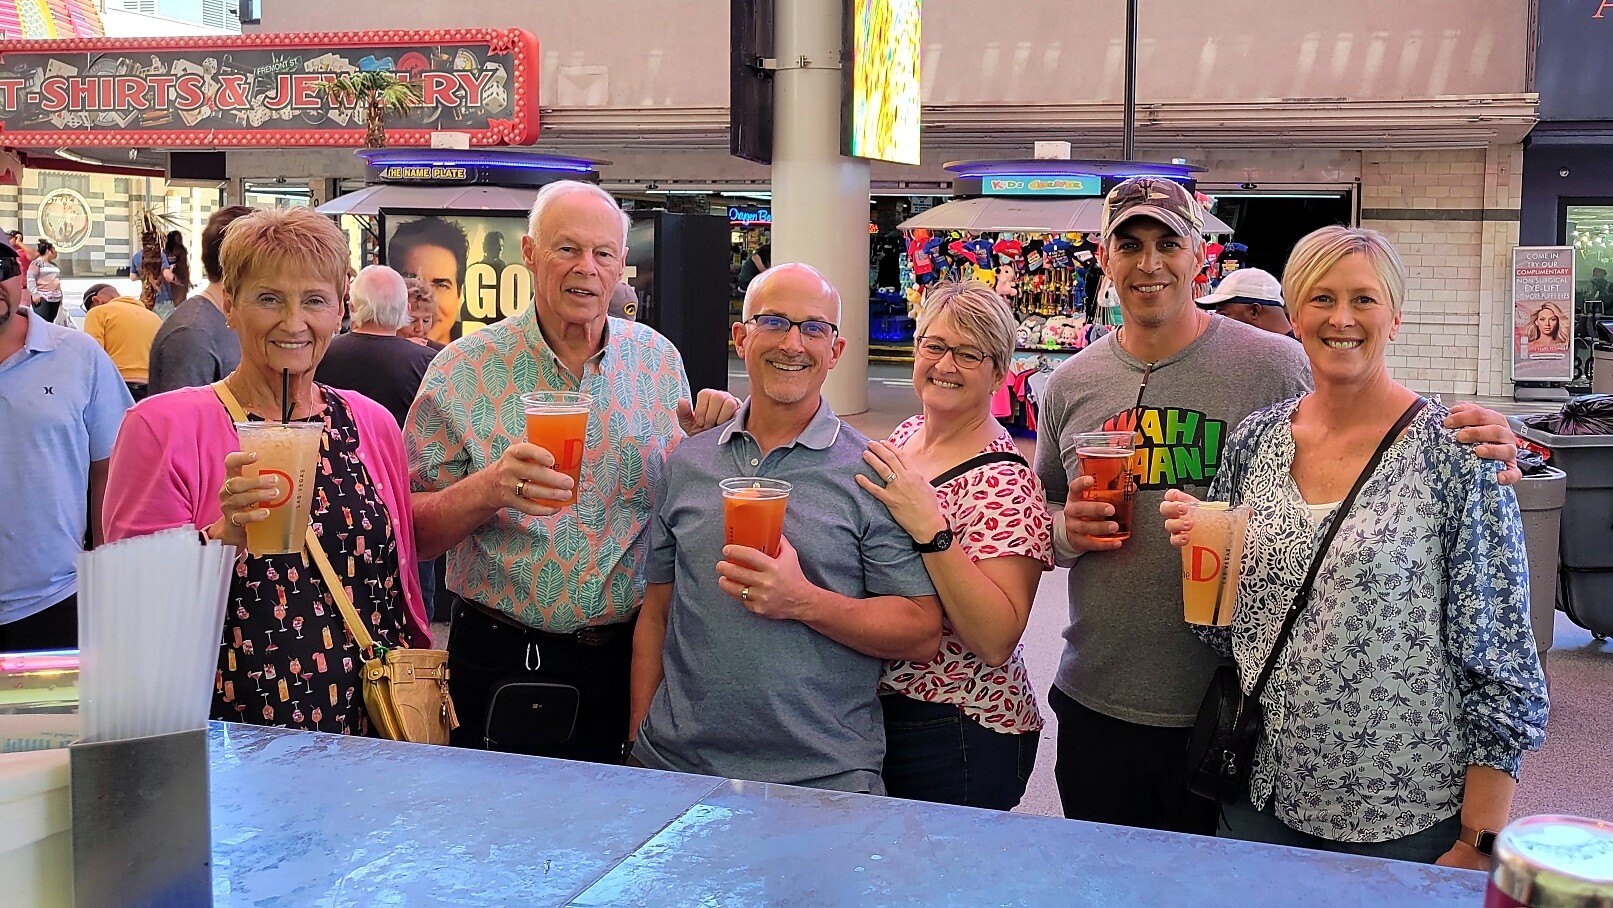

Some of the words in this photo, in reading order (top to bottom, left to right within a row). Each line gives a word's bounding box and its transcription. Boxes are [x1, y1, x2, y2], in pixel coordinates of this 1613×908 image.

[257, 61, 288, 76] FREMONT
[0, 75, 203, 111] T-SHIRTS
[217, 74, 251, 109] &
[387, 167, 402, 178] THE
[404, 167, 431, 178] NAME
[432, 167, 466, 179] PLATE
[47, 196, 72, 204] STEAK
[729, 208, 757, 226] Oxygen
[757, 209, 772, 222] Ba
[1516, 268, 1569, 276] COMPLIMENTARY
[1191, 545, 1221, 582] D
